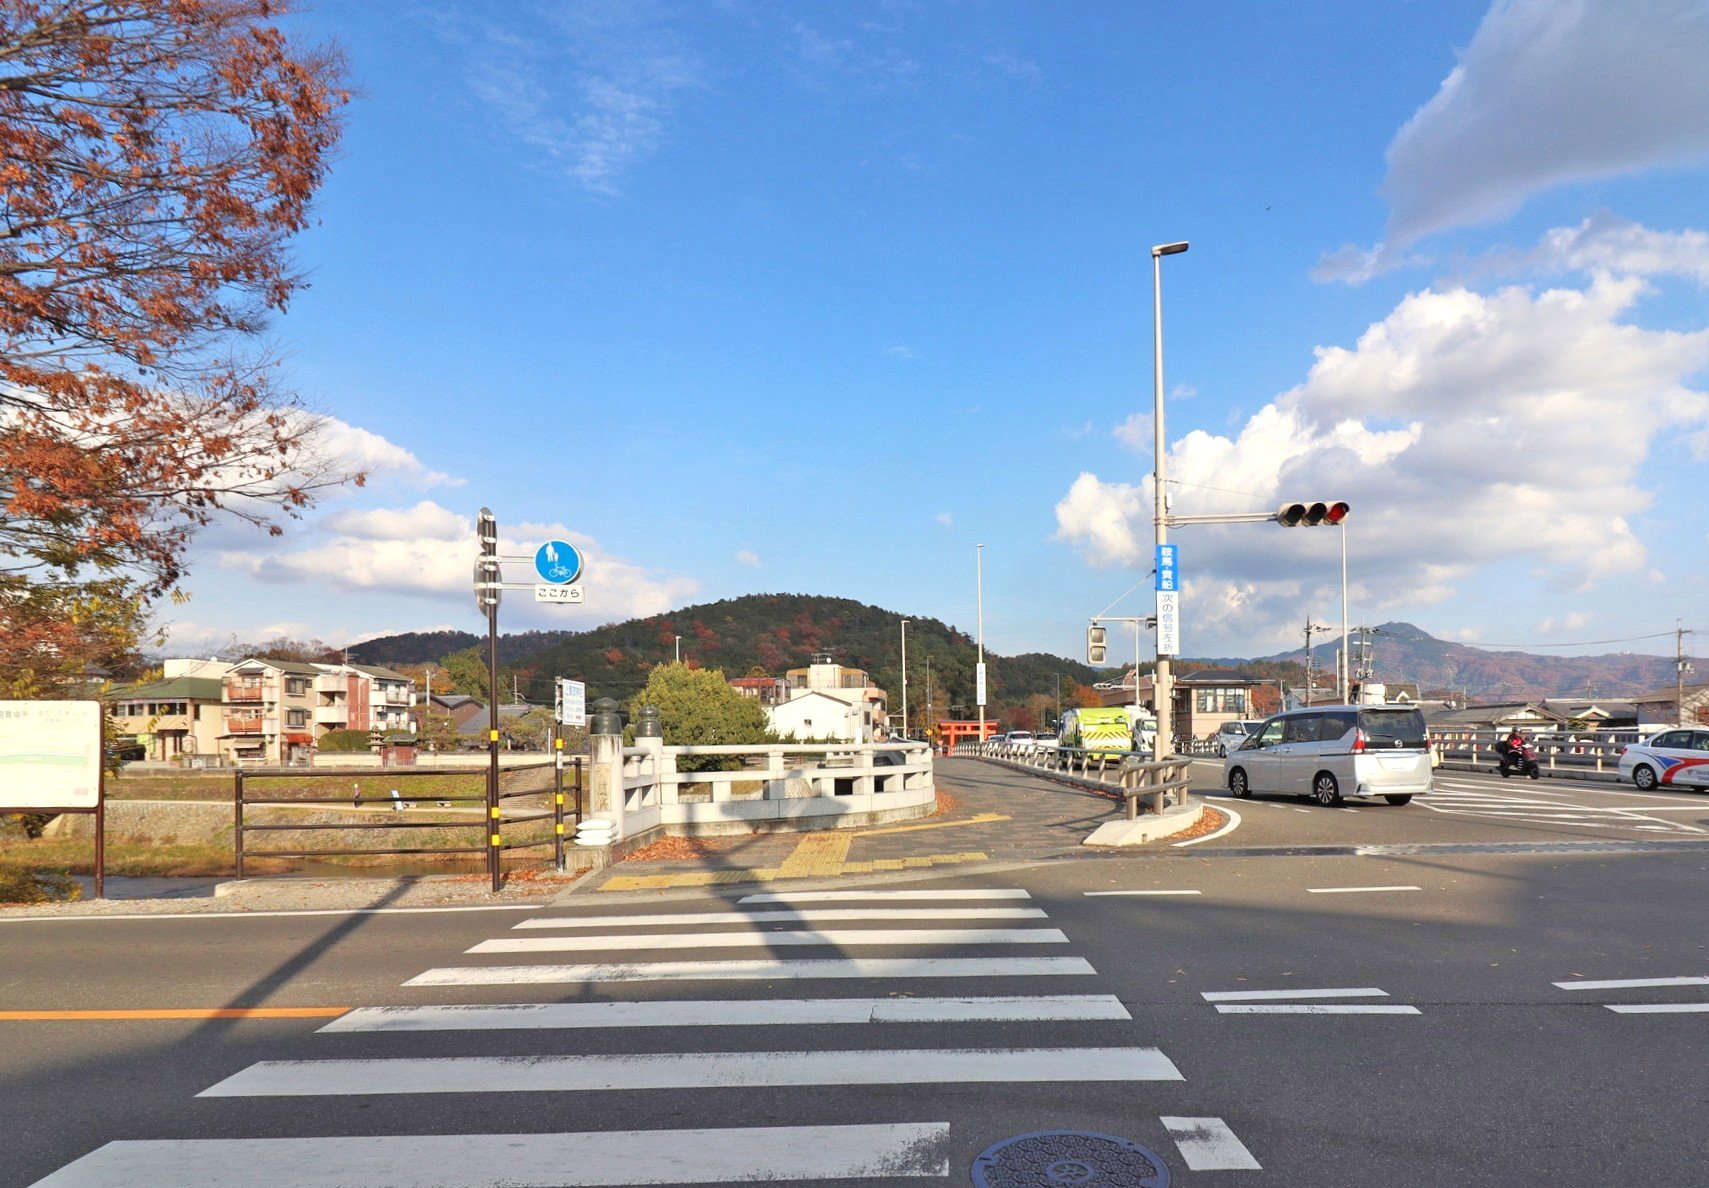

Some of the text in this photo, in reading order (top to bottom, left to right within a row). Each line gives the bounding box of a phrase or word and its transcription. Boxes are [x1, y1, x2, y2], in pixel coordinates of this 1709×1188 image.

[538, 588, 580, 598] ここから
[1162, 594, 1174, 652] 次の信号左折
